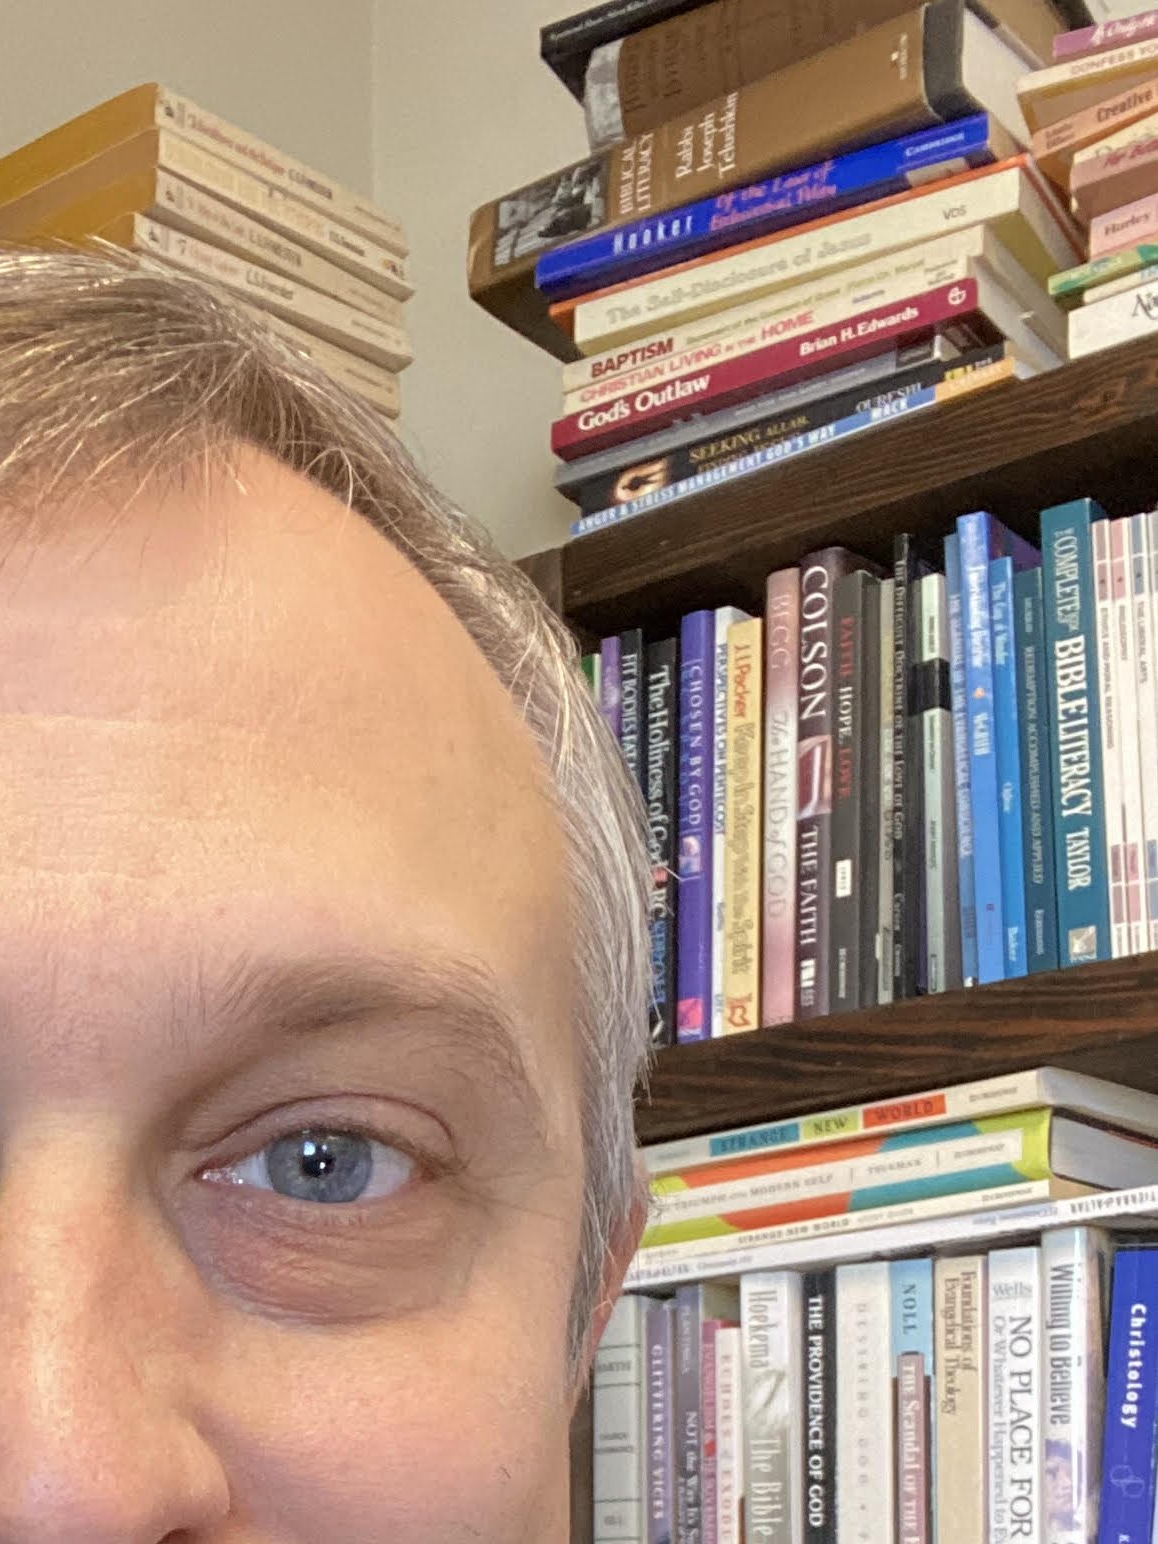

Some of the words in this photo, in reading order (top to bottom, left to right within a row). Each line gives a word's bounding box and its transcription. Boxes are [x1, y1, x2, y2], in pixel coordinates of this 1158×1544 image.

[1097, 89, 1153, 123] Creative
[675, 125, 695, 179] Rabbi
[697, 112, 718, 174] Joseph
[717, 91, 739, 180] Telushkin
[620, 137, 638, 215] BIBLICAL
[637, 132, 654, 212] LITERACY
[613, 213, 695, 255] Hooker
[606, 297, 640, 326] The
[792, 246, 813, 268] of
[580, 363, 666, 402] CHRISTIAN
[669, 343, 722, 371] LIVING
[760, 309, 816, 342] HOME
[590, 338, 675, 379] BAPTISM
[799, 334, 838, 357] Brian
[577, 401, 630, 432] God's
[634, 374, 711, 417] Outlaw
[871, 399, 909, 422] MACK
[689, 427, 760, 464] SEEKING
[577, 512, 617, 533] ANGER
[632, 489, 676, 516] STRESS
[678, 452, 763, 501] MANAGEMENT
[765, 437, 805, 470] GOD'S
[808, 423, 837, 449] WAY
[1054, 536, 1080, 616] COMPLETE
[769, 593, 795, 669] BEGG
[799, 565, 829, 721] COLSON
[621, 652, 639, 676] FIT
[647, 665, 675, 711] The
[1055, 635, 1086, 713] BIBLE
[621, 679, 639, 732] BODIES
[686, 665, 703, 747] CHOSEN
[768, 713, 790, 747] The
[647, 711, 672, 800] Holiness
[686, 756, 703, 778] BY
[1060, 713, 1093, 817] LITERACY
[648, 802, 673, 825] of
[686, 784, 703, 826] GOD
[768, 751, 790, 824] HAND
[766, 829, 790, 847] of
[798, 824, 818, 872] THE
[1068, 827, 1092, 892] TAYLOR
[768, 851, 790, 920] GOD
[798, 878, 818, 946] FAITH
[717, 1126, 788, 1155] STRANGE
[812, 1114, 850, 1137] NEW
[875, 1098, 933, 1123] WORLD
[749, 1180, 801, 1200] MODERN
[803, 1171, 835, 1189] SELF
[808, 1294, 824, 1330] THE
[902, 1283, 917, 1336] NOLL
[941, 1277, 961, 1351] Evangelical
[960, 1271, 978, 1353] Foundations
[992, 1281, 1033, 1297] Wells
[1046, 1263, 1075, 1330] Willing
[748, 1289, 779, 1370] Hoekema
[993, 1316, 1007, 1338] Or
[1009, 1315, 1032, 1359] NO
[1050, 1334, 1073, 1353] to
[808, 1334, 824, 1451] PROVIDENCE
[940, 1356, 961, 1416] Theology
[960, 1357, 978, 1373] of
[993, 1339, 1007, 1418] Whatever
[1049, 1356, 1073, 1426] Believe
[1120, 1302, 1147, 1430] Christology
[651, 1343, 665, 1461] GLITTERING
[685, 1410, 699, 1445] NOT
[1009, 1370, 1033, 1465] PLACE
[750, 1438, 780, 1474] The
[902, 1399, 921, 1469] Scandal
[990, 1422, 1007, 1503] Happened
[651, 1466, 665, 1521] VICES
[808, 1454, 824, 1480] OF
[750, 1480, 783, 1537] Bible
[808, 1483, 824, 1528] GOD
[994, 1509, 1008, 1523] to
[1010, 1477, 1034, 1539] FOR
